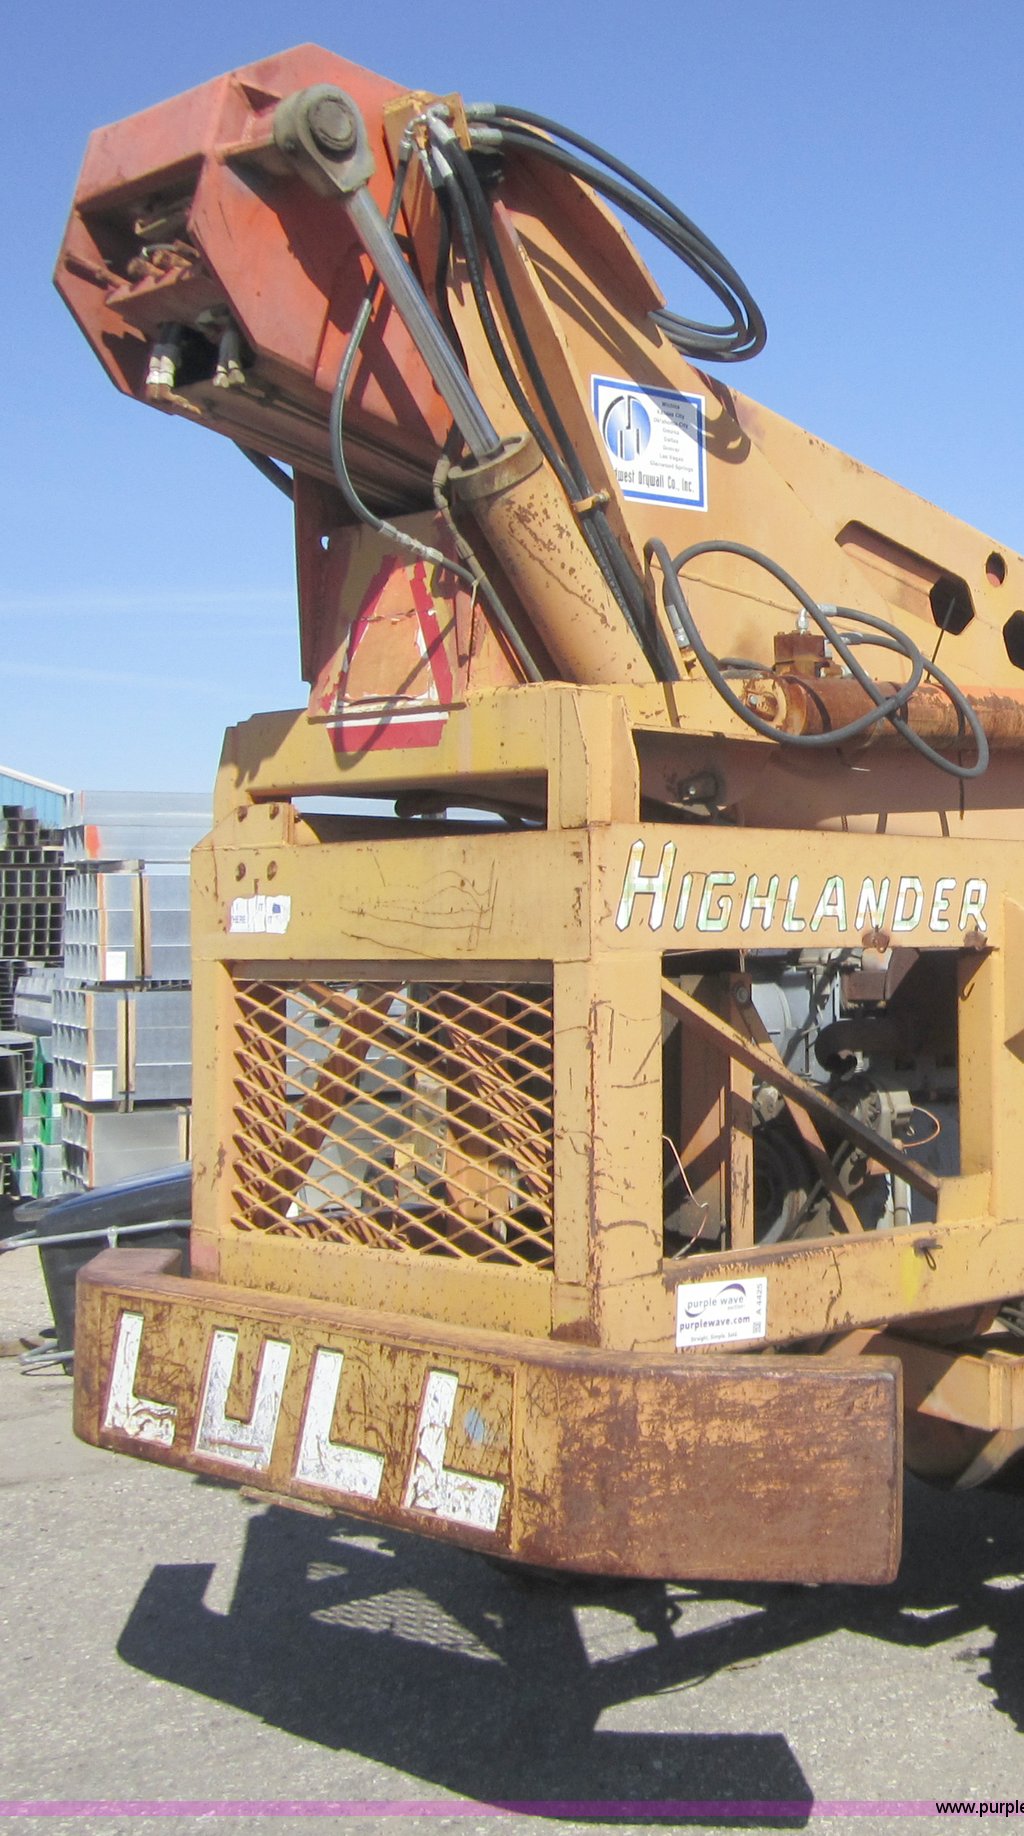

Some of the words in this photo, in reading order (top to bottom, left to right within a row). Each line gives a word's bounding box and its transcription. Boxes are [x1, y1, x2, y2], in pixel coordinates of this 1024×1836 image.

[638, 471, 664, 488] Drywall
[687, 1297, 717, 1309] purple
[720, 1295, 744, 1305] wave
[679, 1316, 751, 1332] purplewave.com
[103, 1309, 506, 1533] LULL
